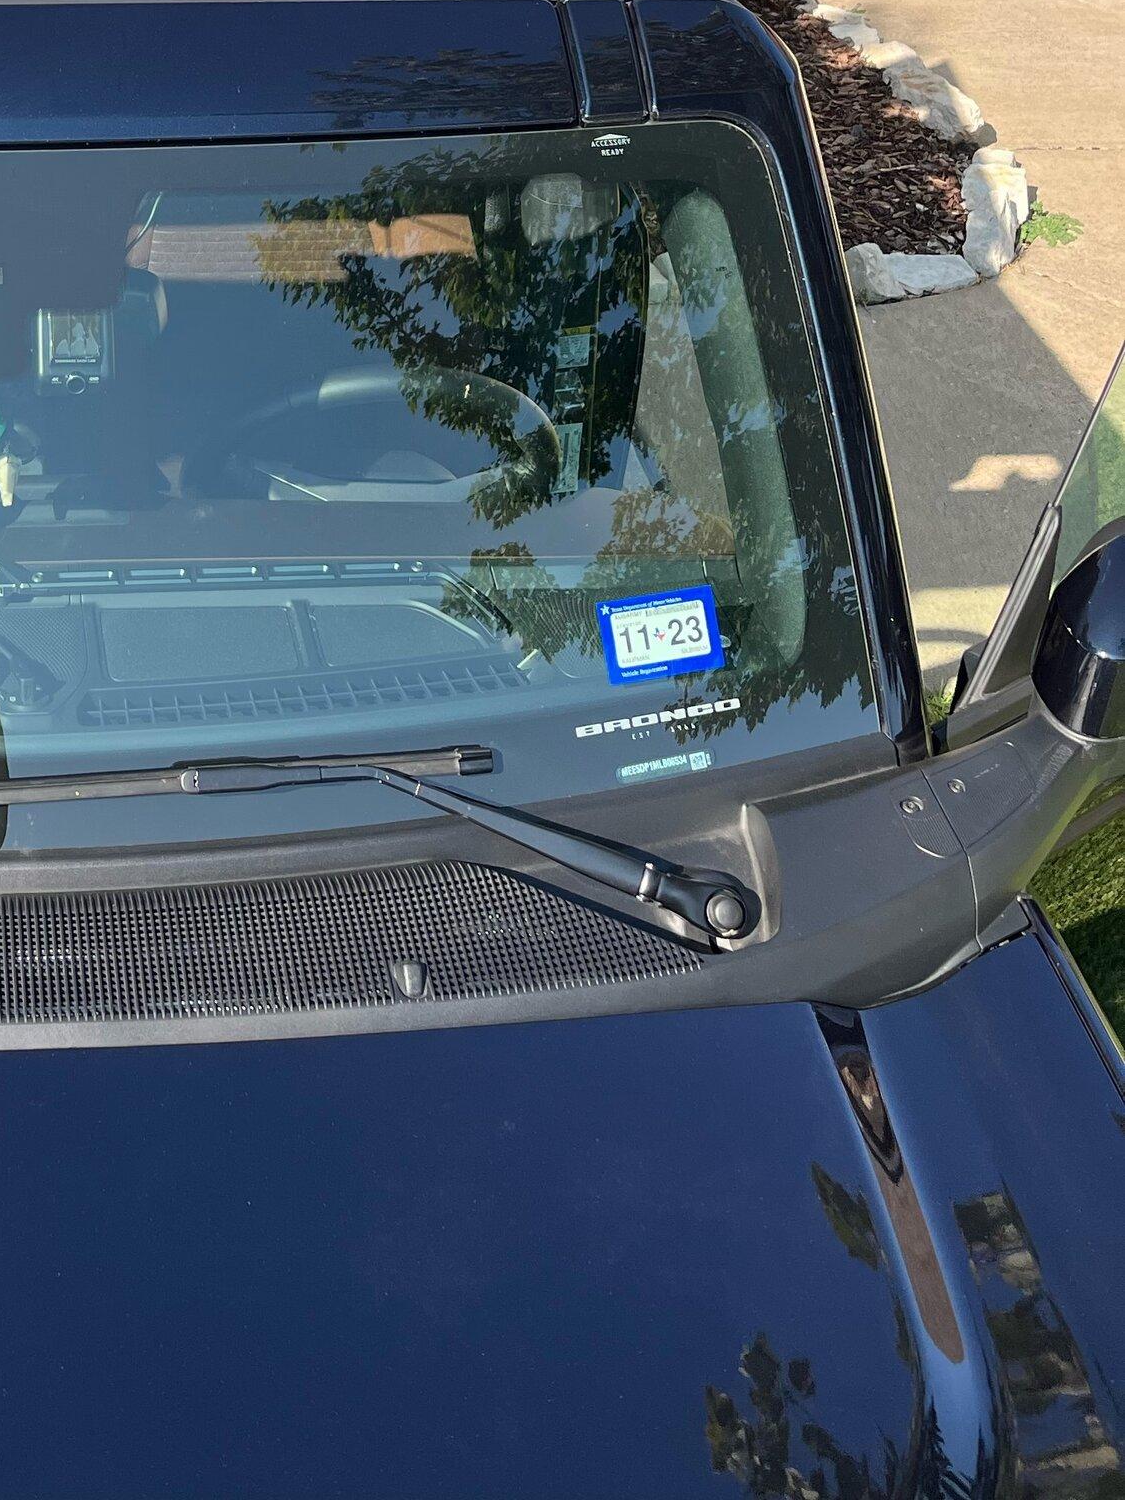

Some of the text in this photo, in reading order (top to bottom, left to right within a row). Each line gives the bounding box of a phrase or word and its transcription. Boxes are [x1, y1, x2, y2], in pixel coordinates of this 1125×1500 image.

[591, 138, 631, 147] ACCESSORY
[601, 148, 624, 157] READY
[620, 616, 703, 653] 11 23
[575, 698, 741, 738] BRONCO
[632, 731, 650, 740] EST
